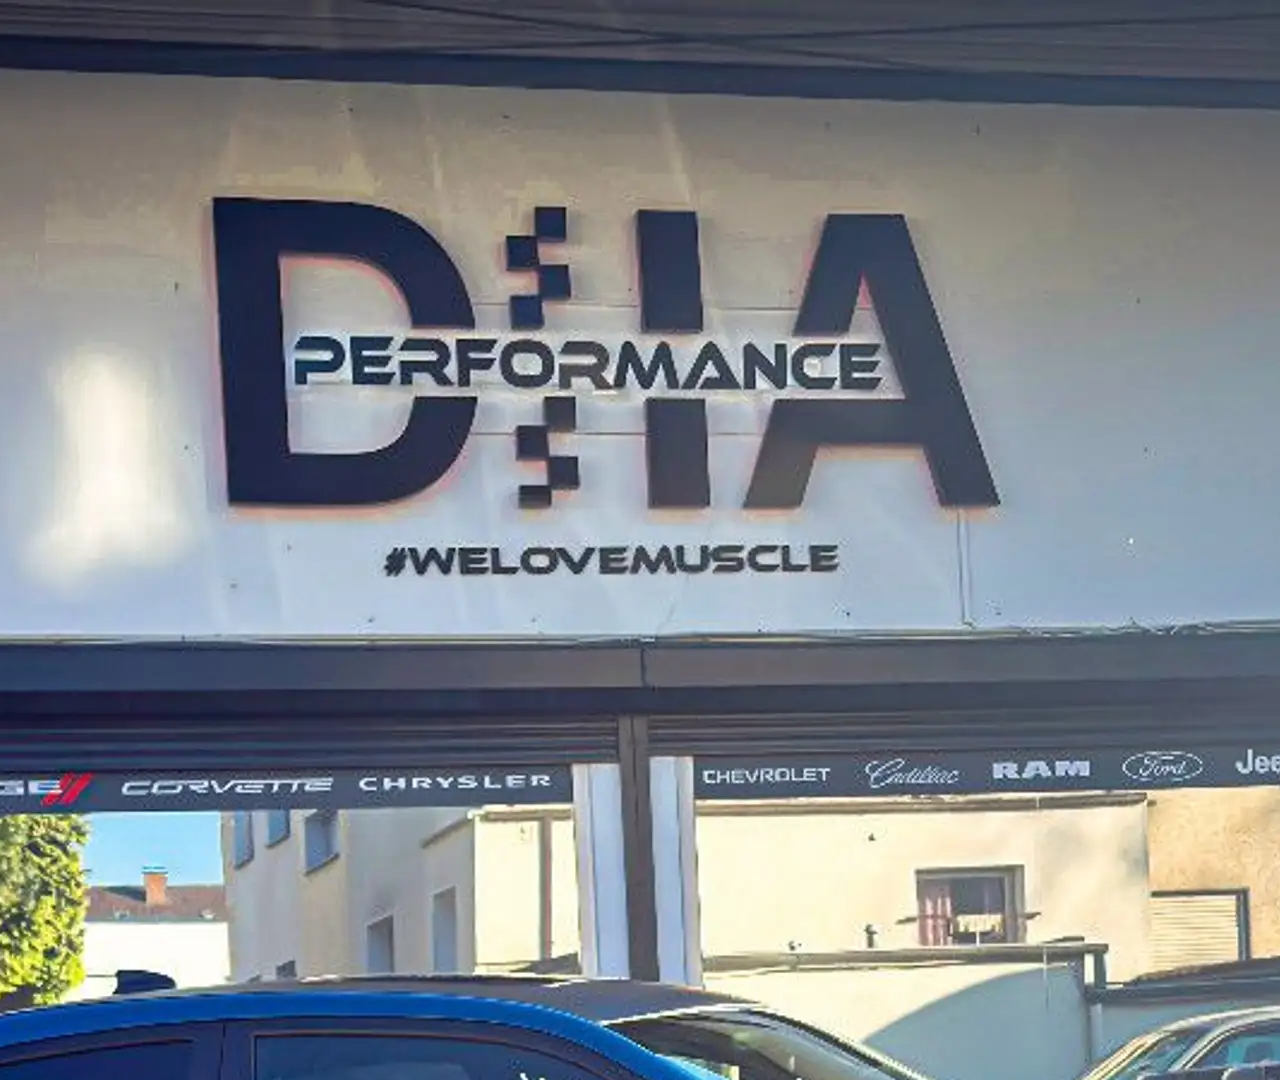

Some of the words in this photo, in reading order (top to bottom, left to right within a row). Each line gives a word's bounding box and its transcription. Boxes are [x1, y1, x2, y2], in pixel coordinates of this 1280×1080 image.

[293, 336, 886, 391] PERFORMANCE
[384, 543, 840, 577] #WELOVEMUSCLE
[121, 778, 334, 795] CORVETTE
[358, 774, 552, 792] CHRYSLER
[702, 767, 831, 782] CHEVROLET
[865, 757, 960, 788] Cadillac
[992, 759, 1091, 780] RAM
[1139, 754, 1187, 776] Ford
